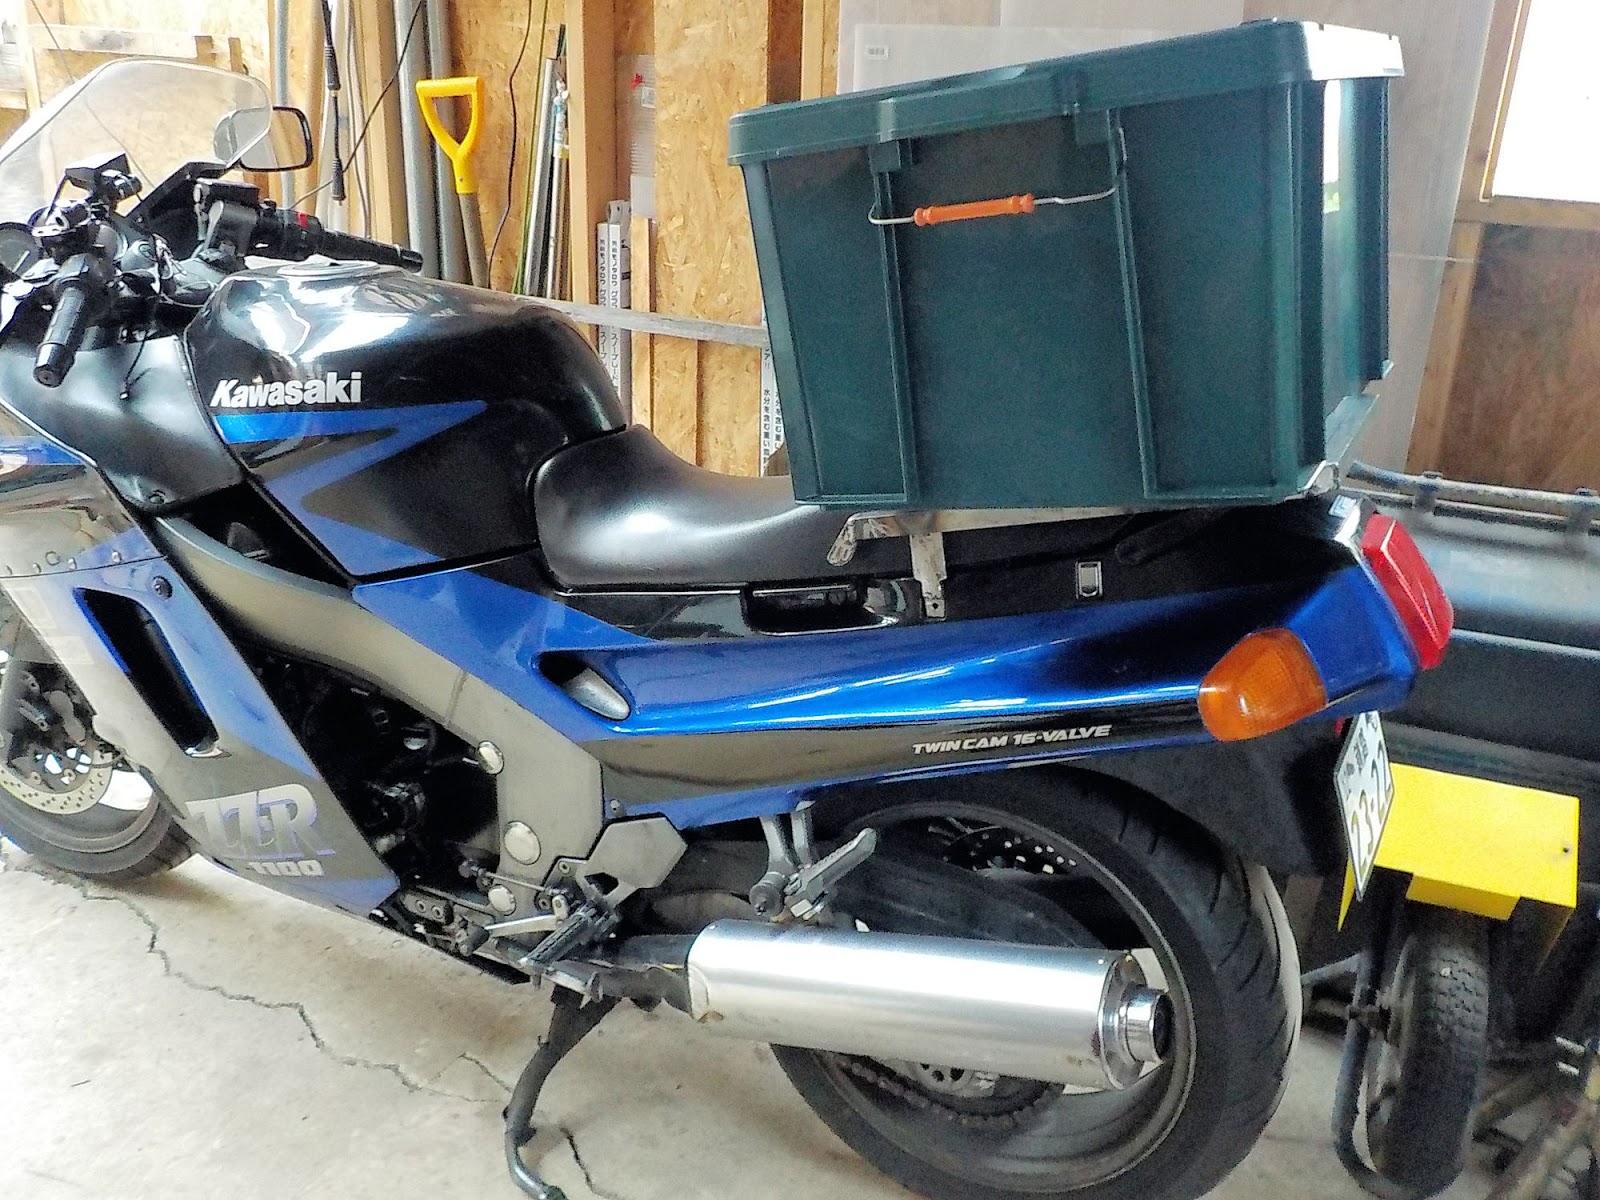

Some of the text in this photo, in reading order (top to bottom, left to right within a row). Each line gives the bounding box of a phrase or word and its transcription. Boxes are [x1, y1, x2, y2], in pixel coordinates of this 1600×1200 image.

[209, 371, 362, 408] Kawasaki
[912, 724, 1114, 755] TWIN CAM 16-VALVE
[248, 859, 325, 877] 1100
